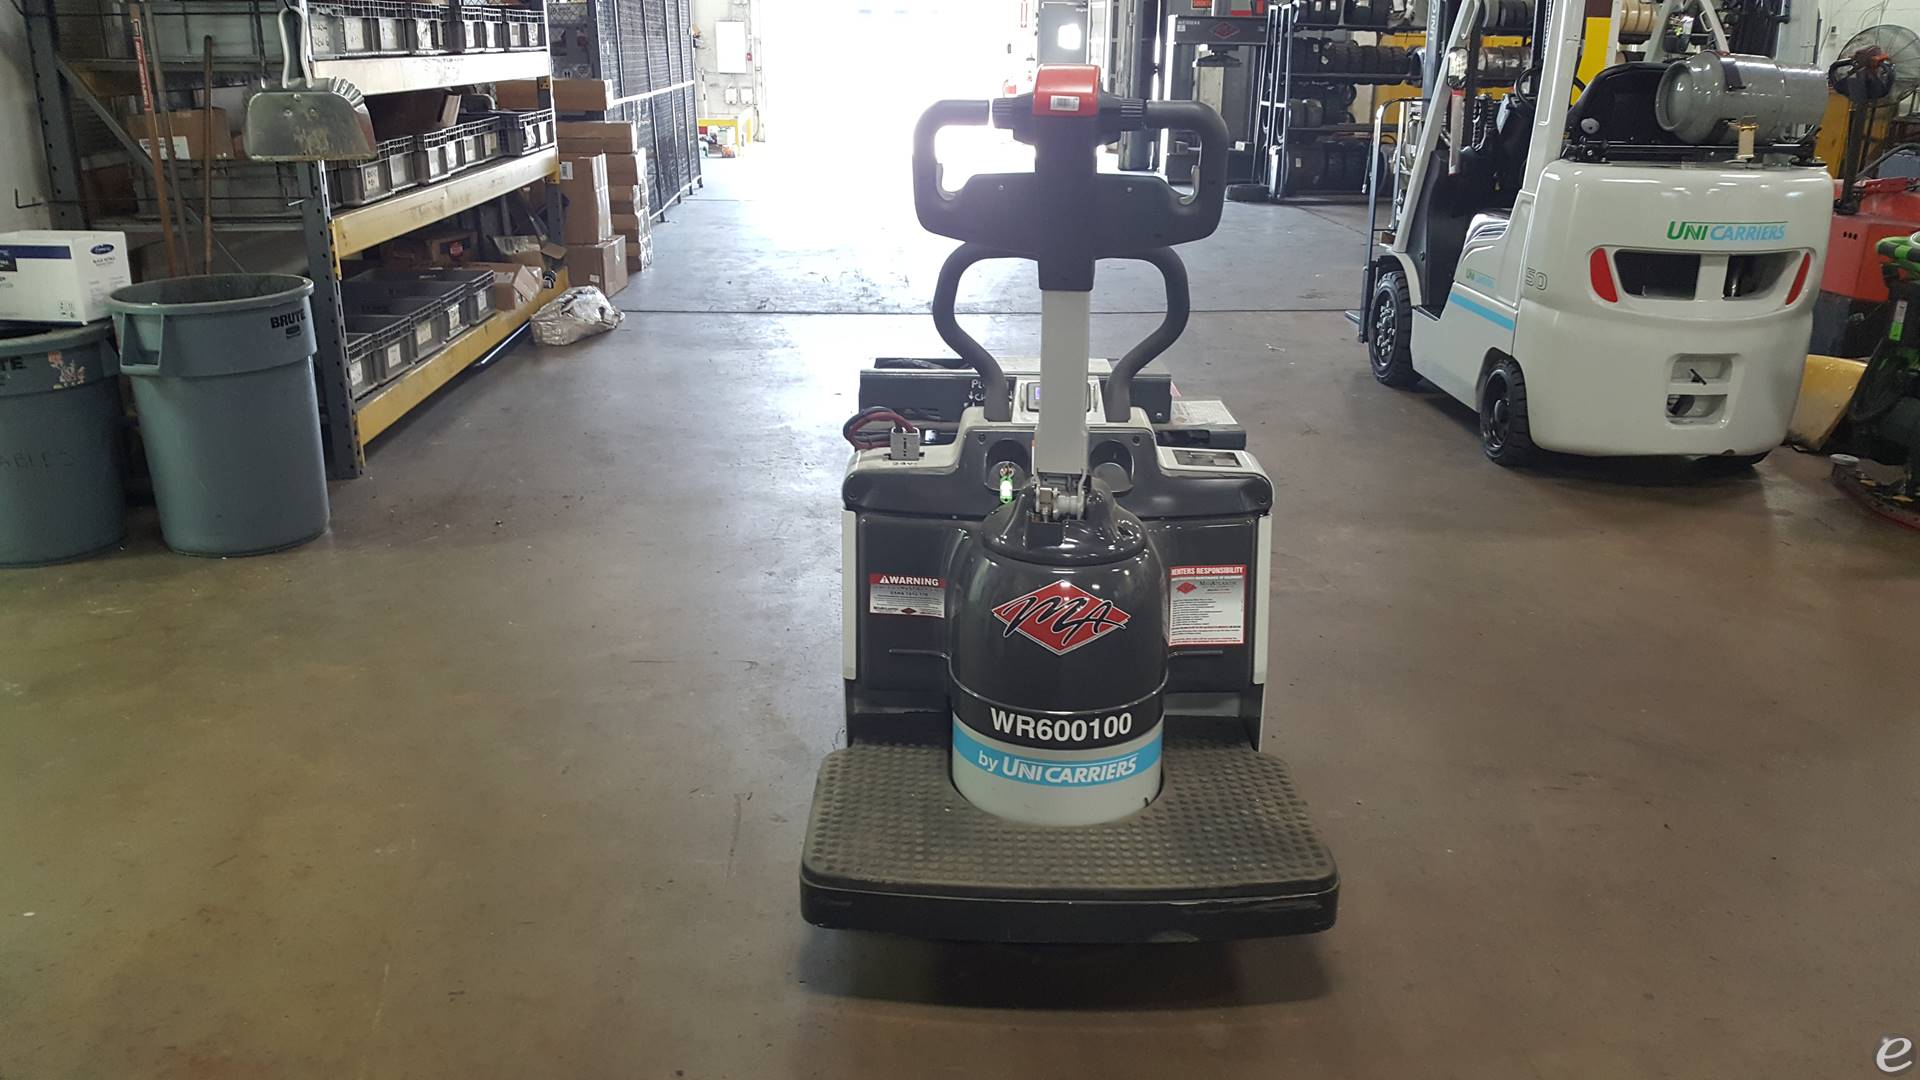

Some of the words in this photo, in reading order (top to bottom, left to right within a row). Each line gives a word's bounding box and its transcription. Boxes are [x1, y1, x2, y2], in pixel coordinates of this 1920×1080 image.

[1525, 267, 1549, 291] 50
[271, 308, 306, 328] BRUTE
[889, 576, 939, 586] WARNING
[1196, 566, 1244, 575] RESPONSIBILITY
[990, 707, 1132, 742] WR600100
[978, 750, 999, 772] by
